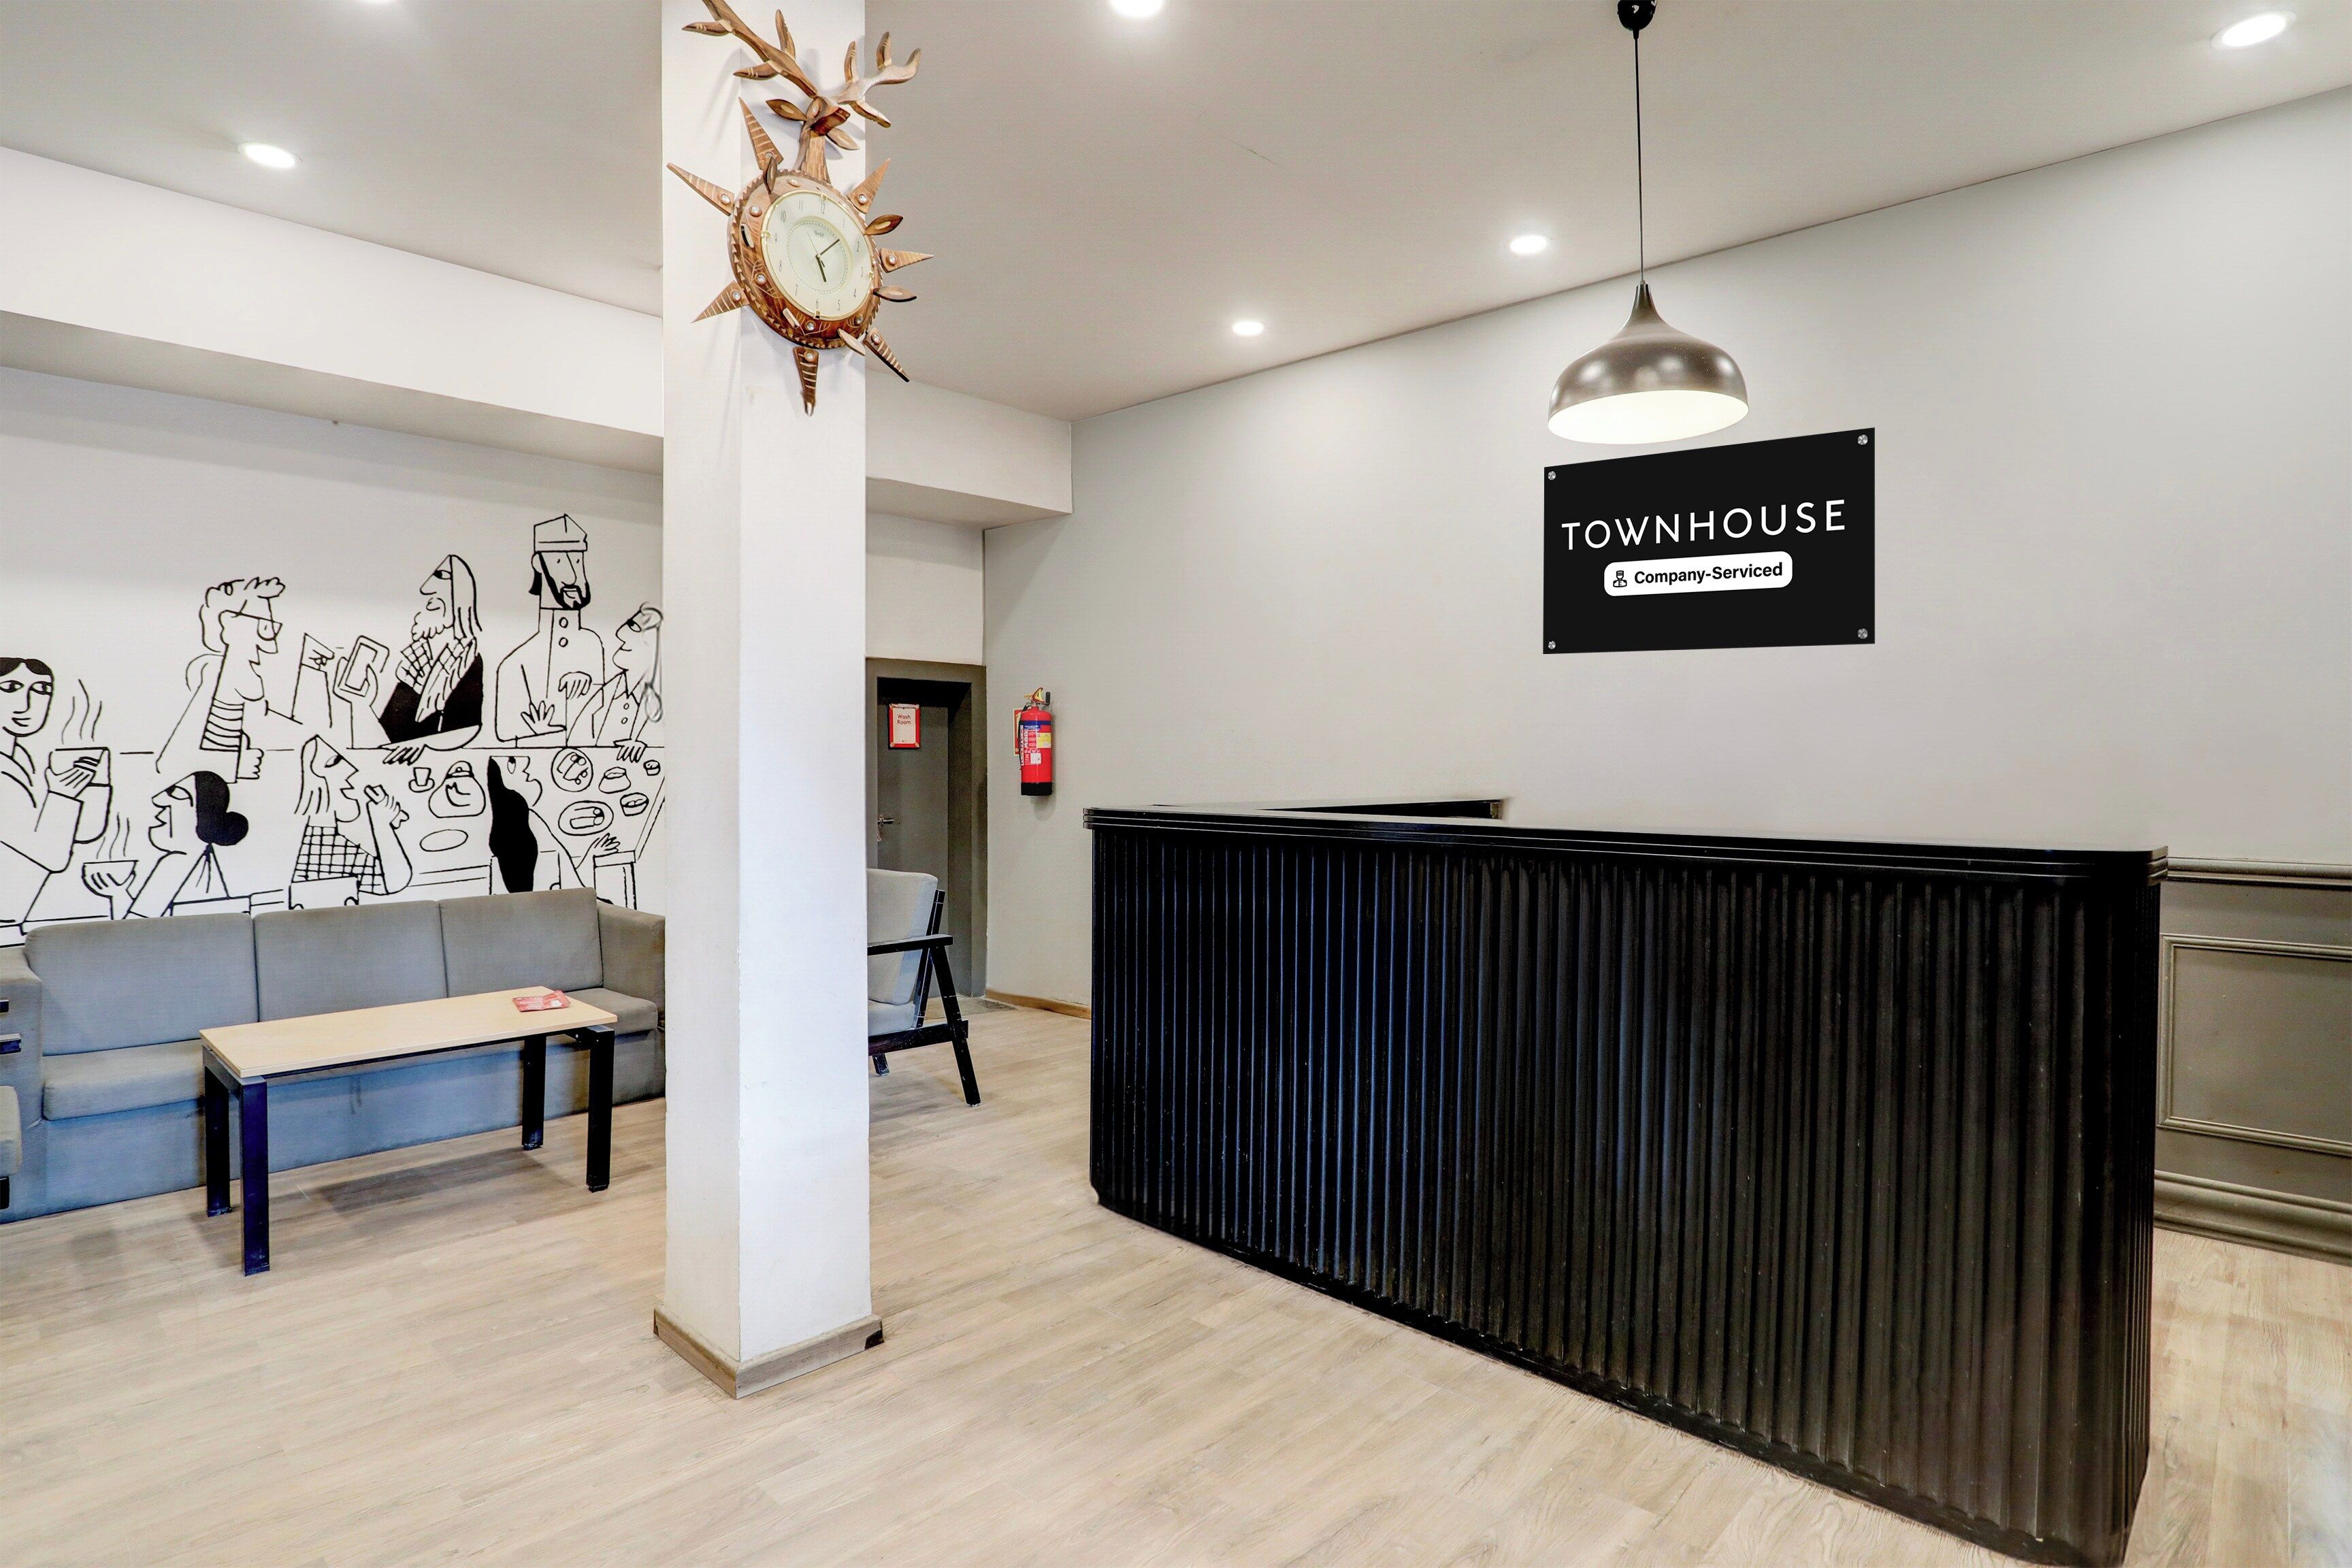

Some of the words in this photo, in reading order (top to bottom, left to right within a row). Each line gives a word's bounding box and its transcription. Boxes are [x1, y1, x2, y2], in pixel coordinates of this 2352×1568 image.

[781, 210, 786, 223] 10
[1561, 499, 1846, 551] TOWNHOUSE
[1633, 561, 1783, 586] Company-Serviced
